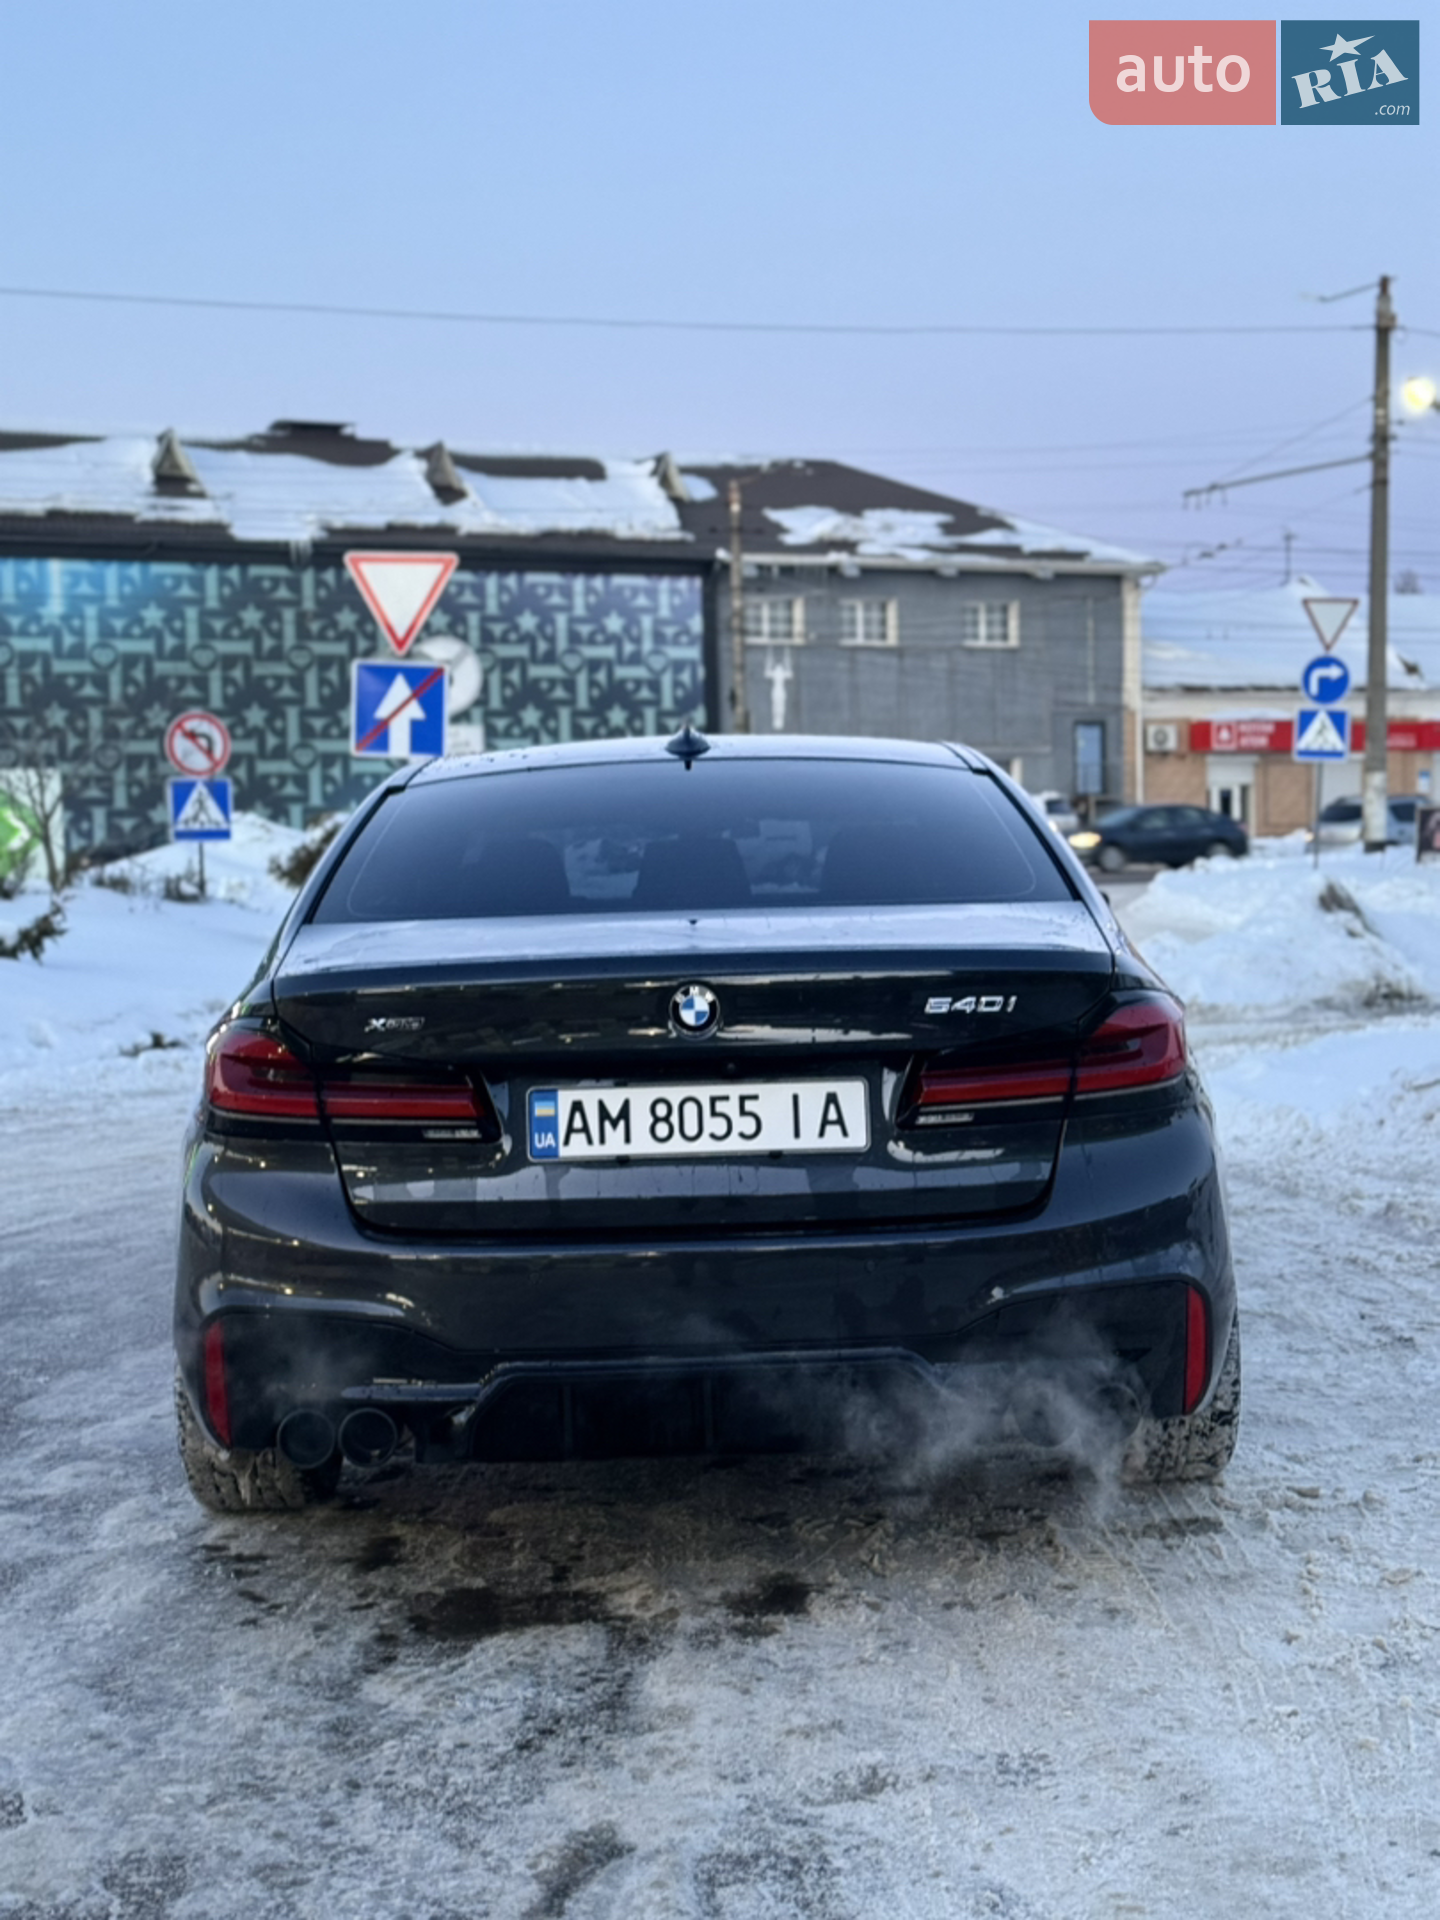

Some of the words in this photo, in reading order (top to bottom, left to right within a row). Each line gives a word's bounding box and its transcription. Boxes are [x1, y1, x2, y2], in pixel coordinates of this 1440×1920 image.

[562, 1097, 631, 1147] AM
[649, 1094, 763, 1144] 8055
[791, 1091, 849, 1141] IA
[534, 1132, 556, 1149] UA
